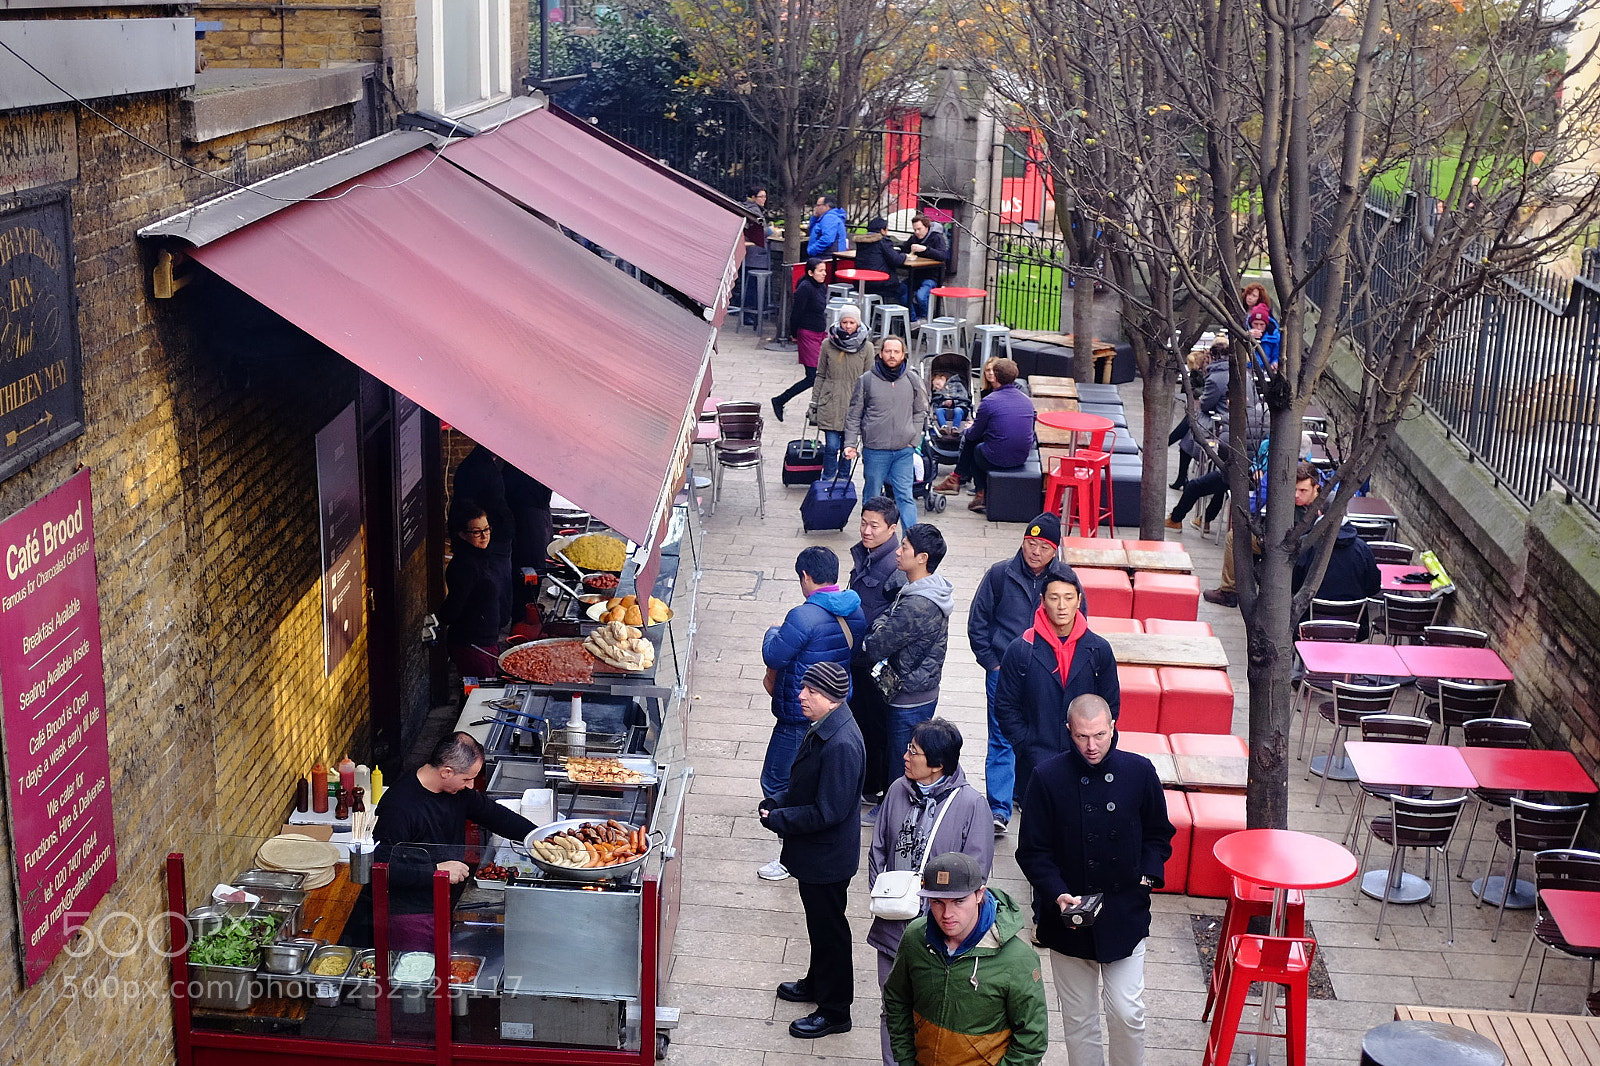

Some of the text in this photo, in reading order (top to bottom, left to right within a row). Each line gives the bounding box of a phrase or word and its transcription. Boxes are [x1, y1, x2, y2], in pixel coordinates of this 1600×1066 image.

[33, 117, 64, 155] COURT
[10, 276, 34, 312] INN
[44, 359, 67, 392] MAY
[6, 500, 83, 580] Café Brood
[2, 587, 27, 613] Famous
[27, 580, 36, 595] for
[76, 537, 90, 560] Food
[23, 598, 81, 655] Breakfast Available
[20, 639, 90, 710] Seating Available Inside
[18, 777, 24, 795] 7
[25, 765, 42, 788] days
[43, 759, 49, 772] a
[49, 739, 67, 766] week
[67, 724, 82, 748] early
[89, 707, 100, 726] late
[29, 691, 89, 755] Café Brood is Open
[24, 831, 58, 873] Functions,
[59, 815, 72, 836] Hire
[72, 804, 78, 821] &
[79, 777, 105, 814] Deliveries
[47, 772, 84, 819] We cater for
[54, 866, 67, 891] 020
[67, 849, 82, 876] 7407
[82, 831, 97, 859] 0644
